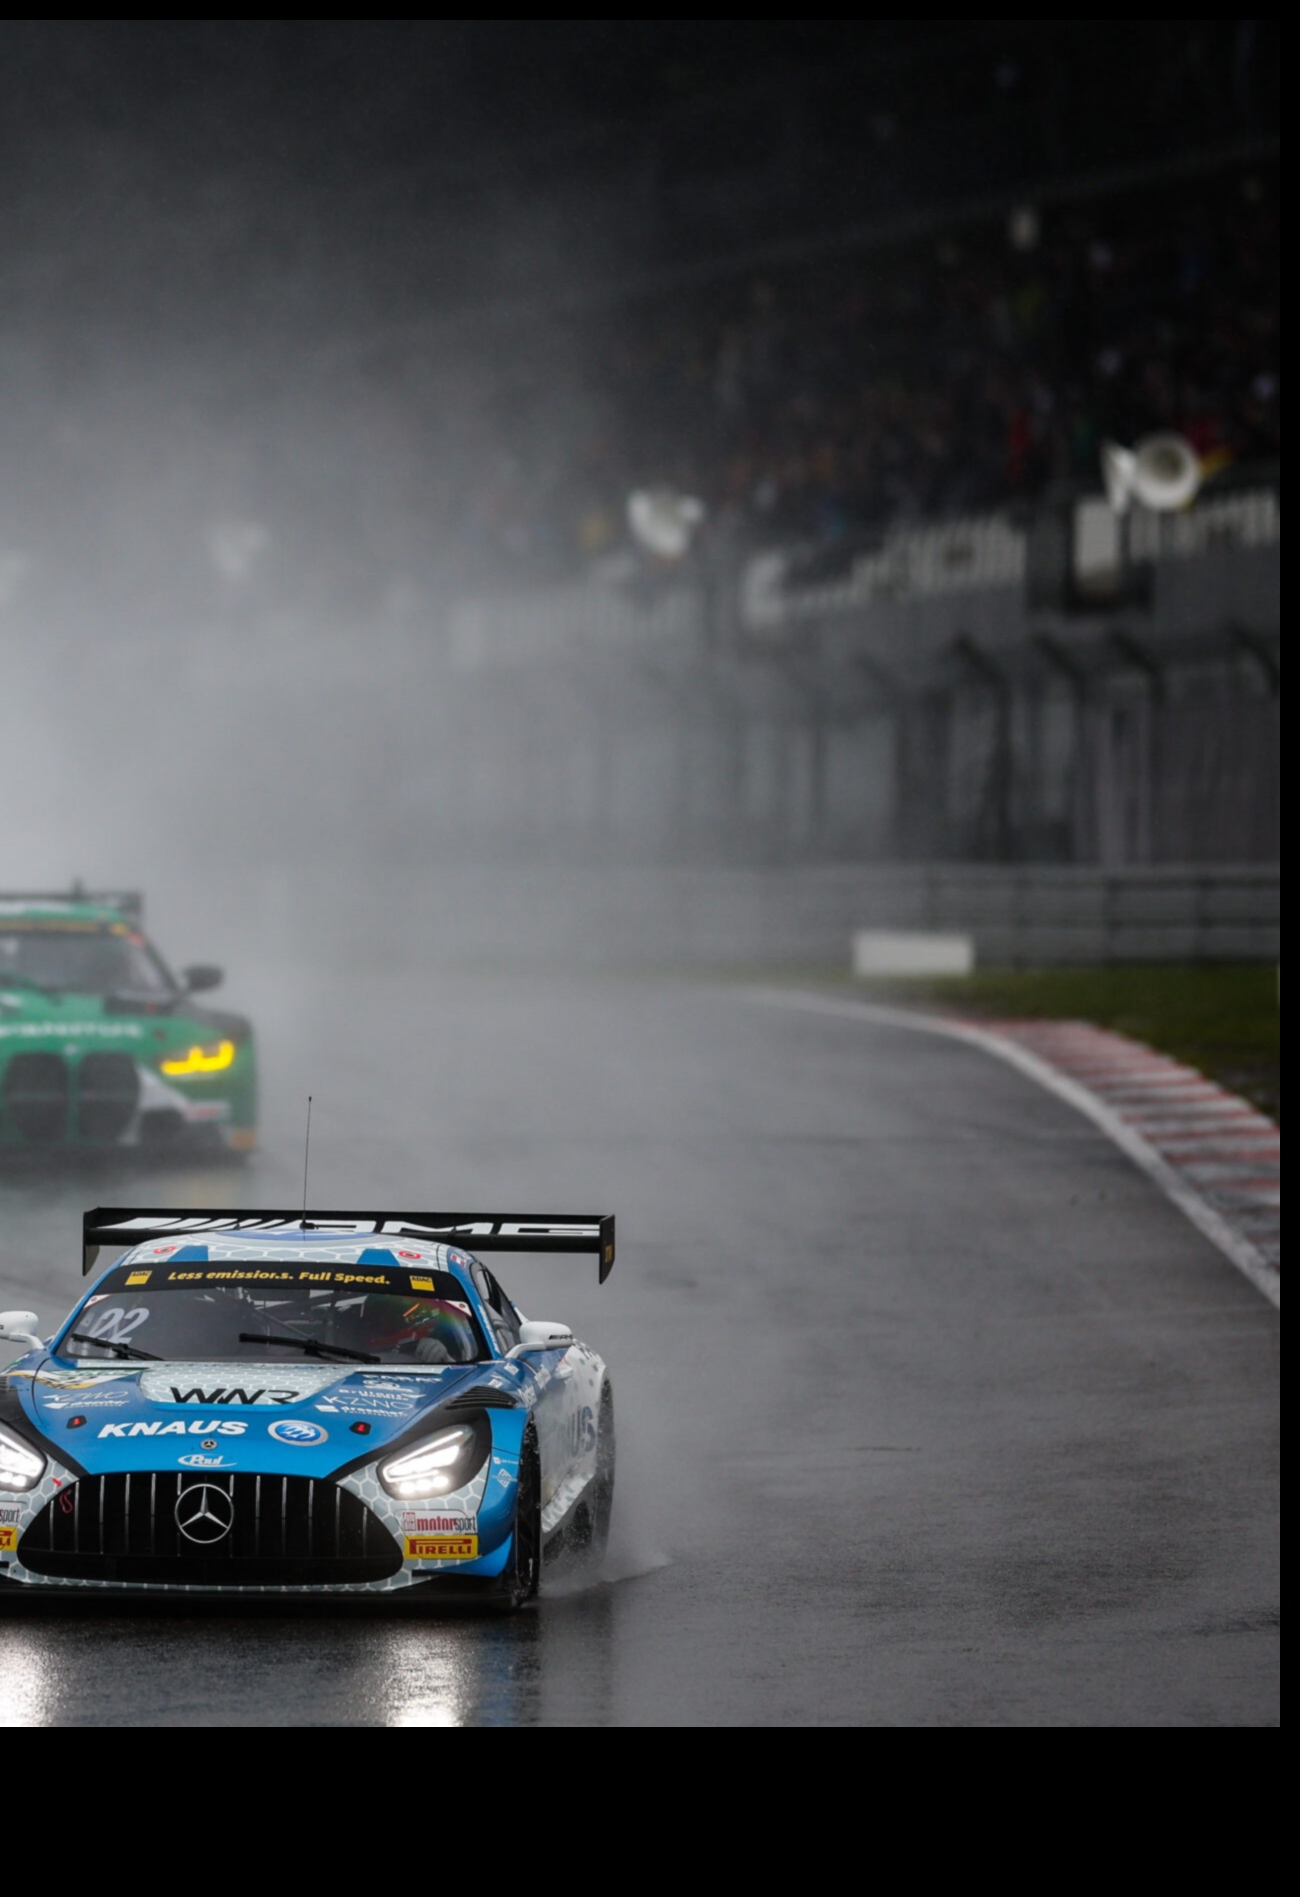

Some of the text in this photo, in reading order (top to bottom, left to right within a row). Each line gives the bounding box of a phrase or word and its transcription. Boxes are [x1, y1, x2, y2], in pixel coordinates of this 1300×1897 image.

[167, 1272, 203, 1280] Less
[298, 1271, 332, 1281] Full
[334, 1272, 391, 1285] Speed.
[88, 1307, 150, 1344] 22
[170, 1387, 300, 1405] WNR
[322, 1395, 414, 1410] KZWO
[97, 1420, 249, 1438] KNAUS
[416, 1515, 476, 1532] motorsport
[409, 1538, 472, 1555] PIRELLI
